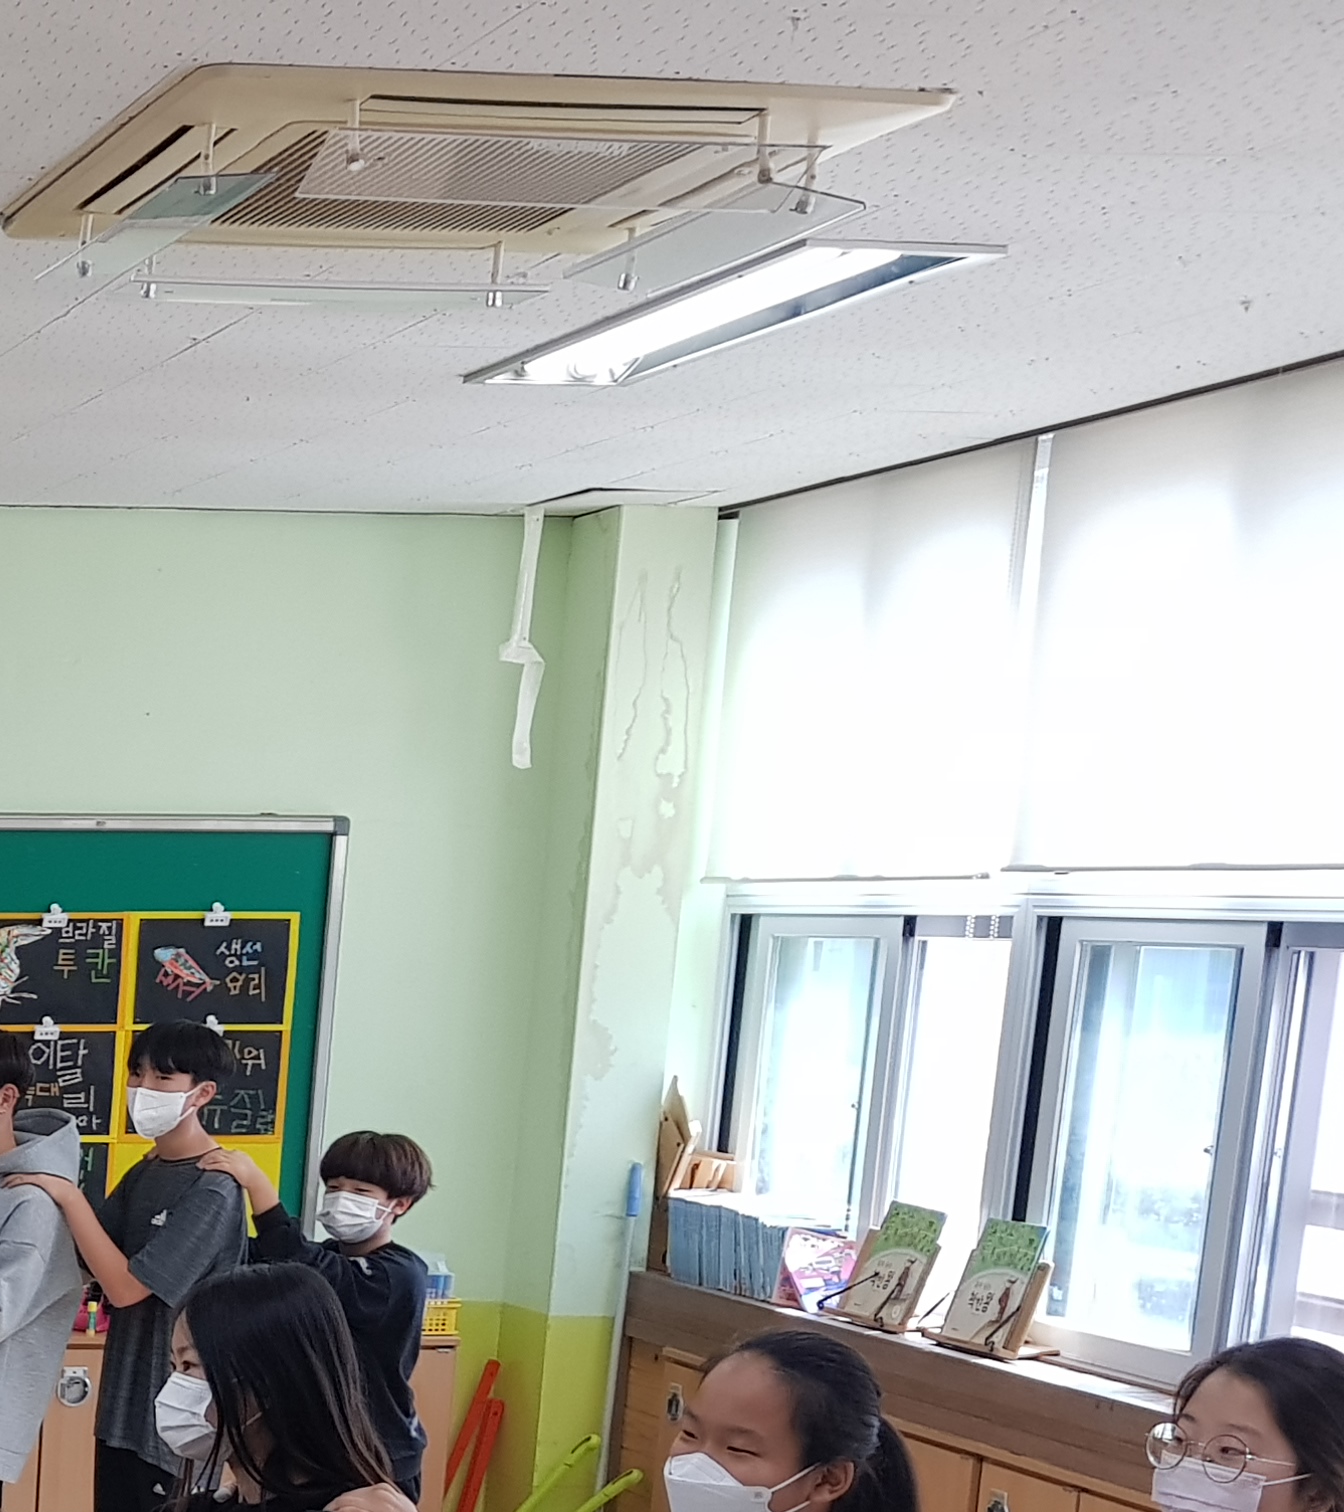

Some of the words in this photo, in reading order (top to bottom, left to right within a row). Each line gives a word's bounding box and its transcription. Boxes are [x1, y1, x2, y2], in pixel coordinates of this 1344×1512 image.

[58, 920, 118, 949] 브라질
[53, 949, 117, 983] 투칸
[216, 939, 262, 967] 생선
[225, 967, 267, 1002] 요리
[28, 1039, 89, 1087] 이탈
[62, 1085, 95, 1112] 리
